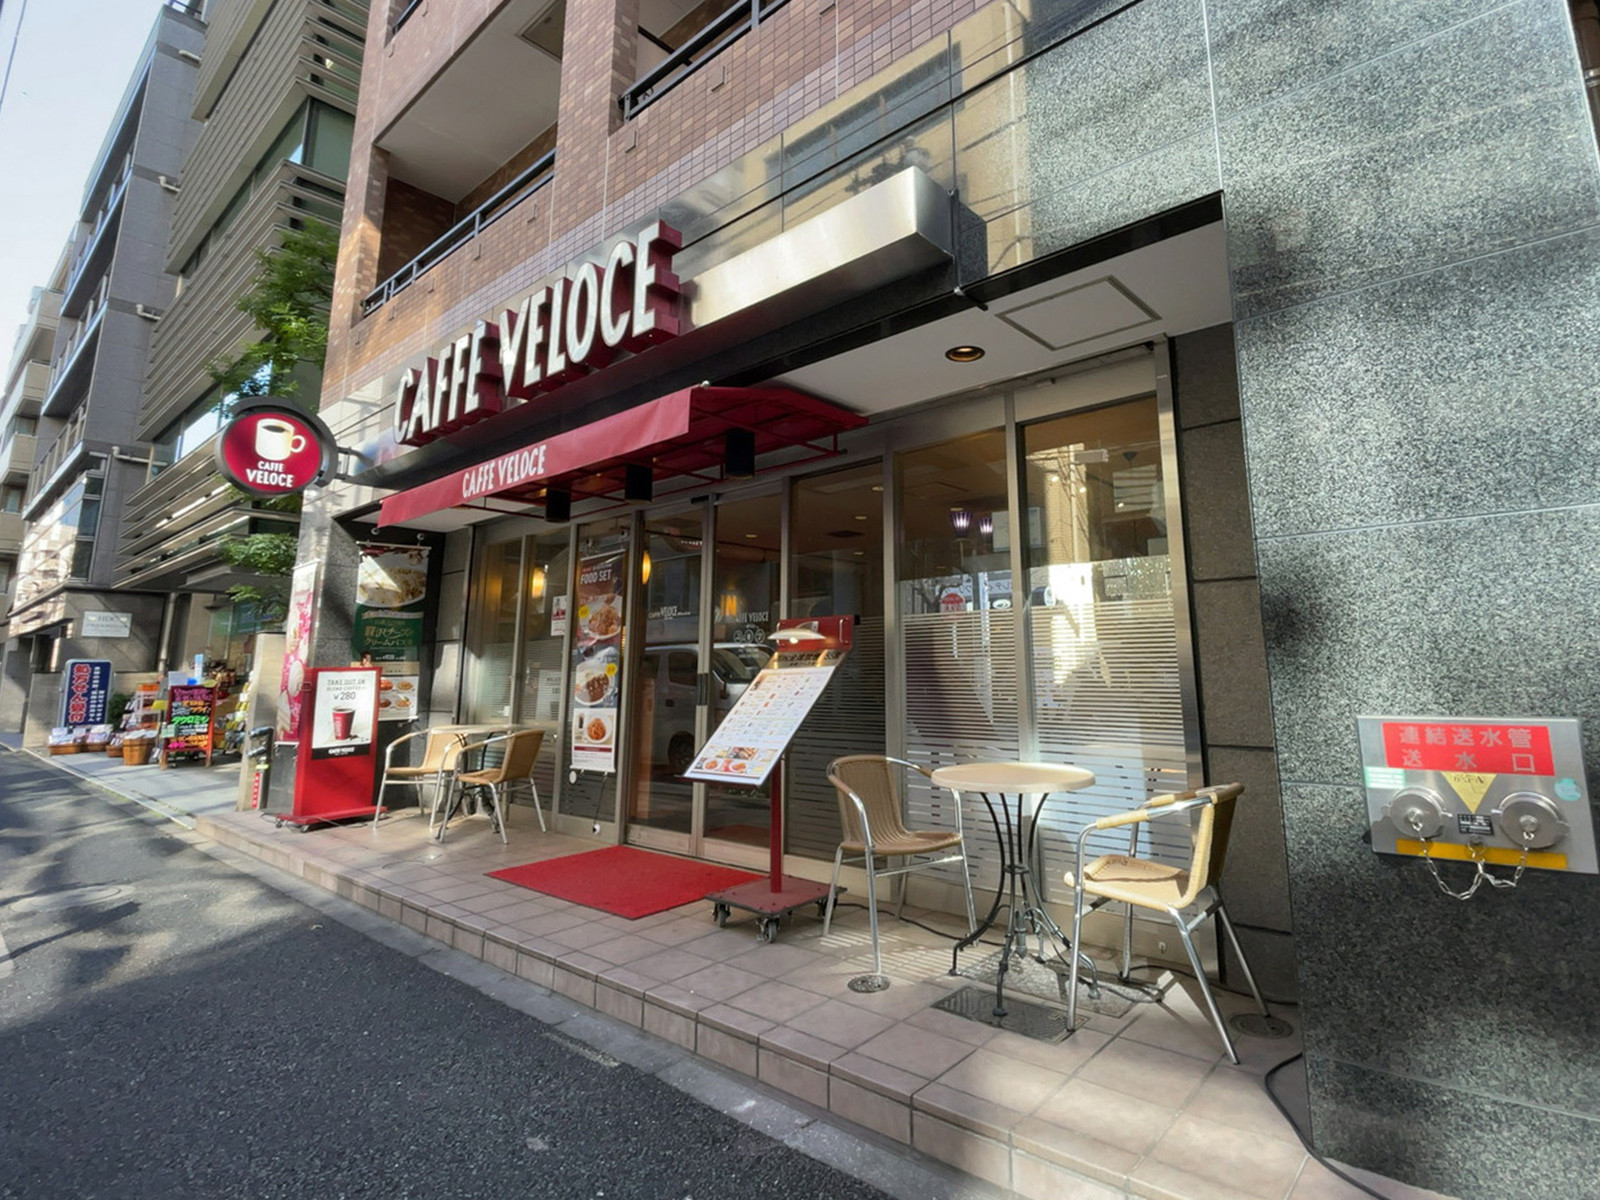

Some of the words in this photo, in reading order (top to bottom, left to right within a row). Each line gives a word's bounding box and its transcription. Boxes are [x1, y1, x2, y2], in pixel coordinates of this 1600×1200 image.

[498, 220, 663, 397] VELOCE
[498, 444, 547, 486] VELOCE
[245, 468, 294, 488] VELOCE
[580, 571, 598, 584] FOOD
[598, 568, 612, 582] SET
[1399, 726, 1533, 749] 連結送水管
